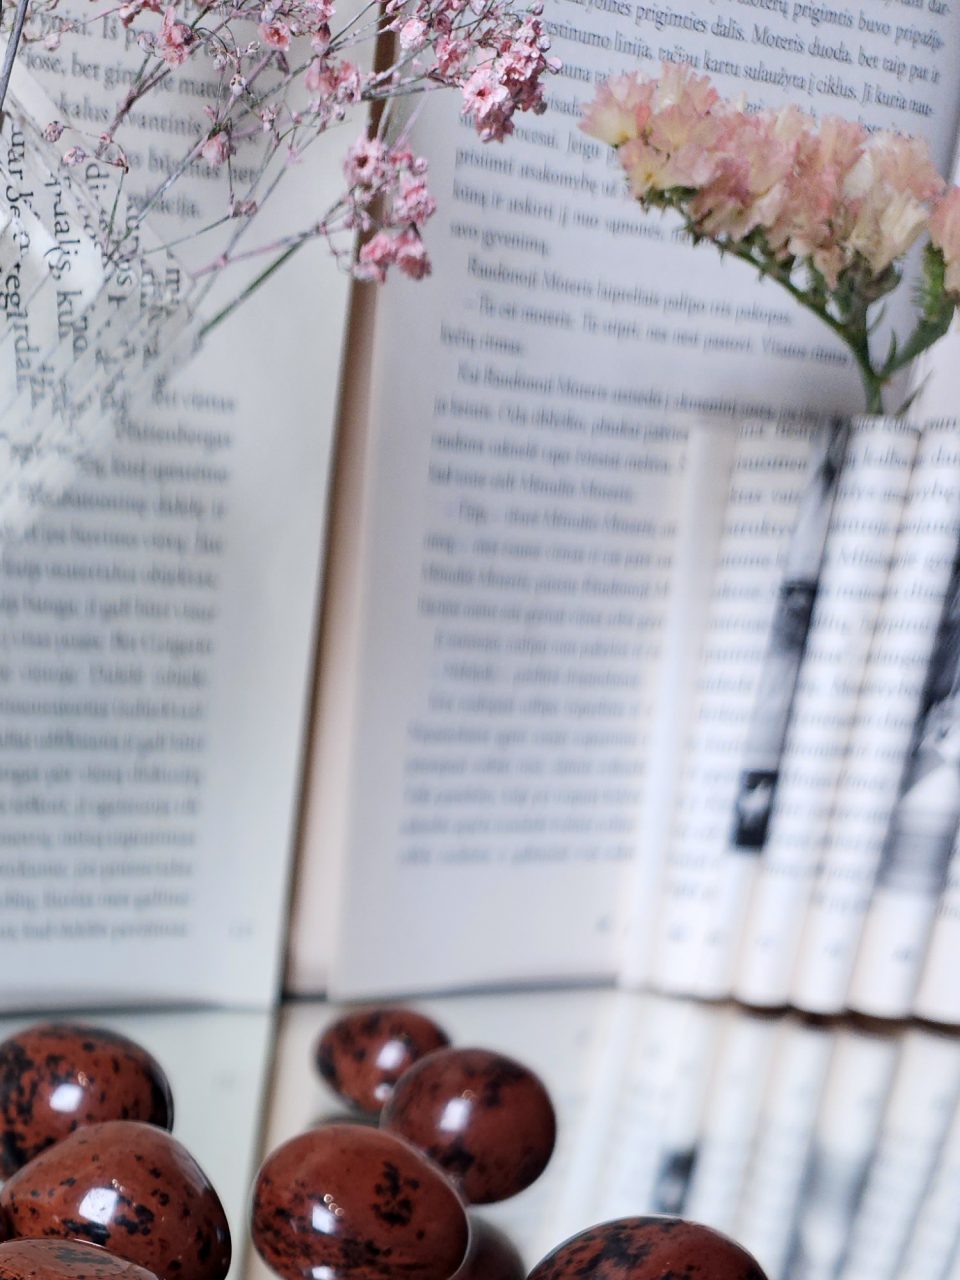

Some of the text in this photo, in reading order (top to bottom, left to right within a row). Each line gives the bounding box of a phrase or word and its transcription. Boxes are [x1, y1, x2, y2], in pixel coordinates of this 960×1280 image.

[858, 10, 890, 35] buvo
[751, 23, 805, 54] Moteris
[703, 49, 739, 78] kartu
